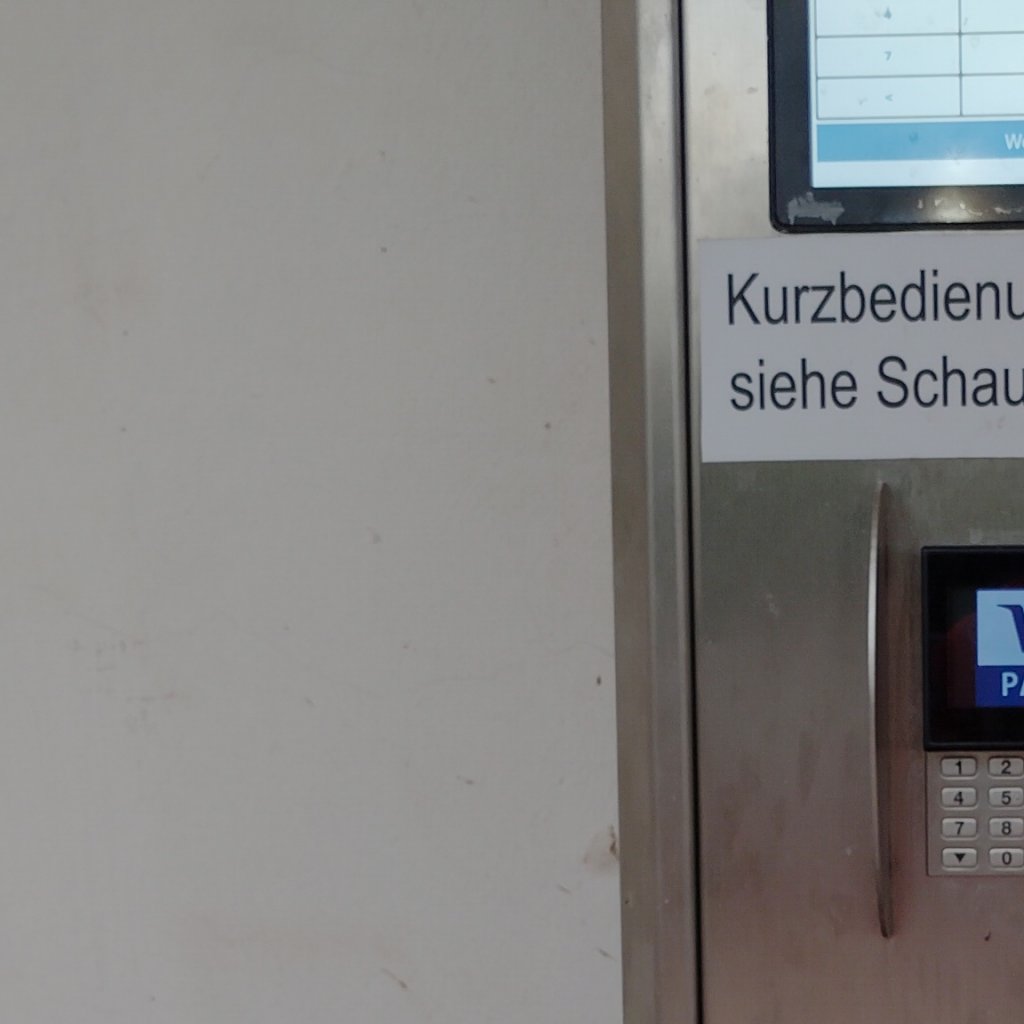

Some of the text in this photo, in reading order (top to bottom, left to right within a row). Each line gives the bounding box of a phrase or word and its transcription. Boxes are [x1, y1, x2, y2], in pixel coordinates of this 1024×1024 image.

[884, 50, 892, 61] 7
[730, 358, 859, 411] siehe
[955, 760, 962, 775] 1
[1001, 760, 1011, 775] 2
[953, 791, 963, 806] 4
[1001, 791, 1011, 805] 5
[954, 821, 964, 836] 7
[1001, 821, 1011, 836] 8
[1002, 851, 1012, 866] 0
